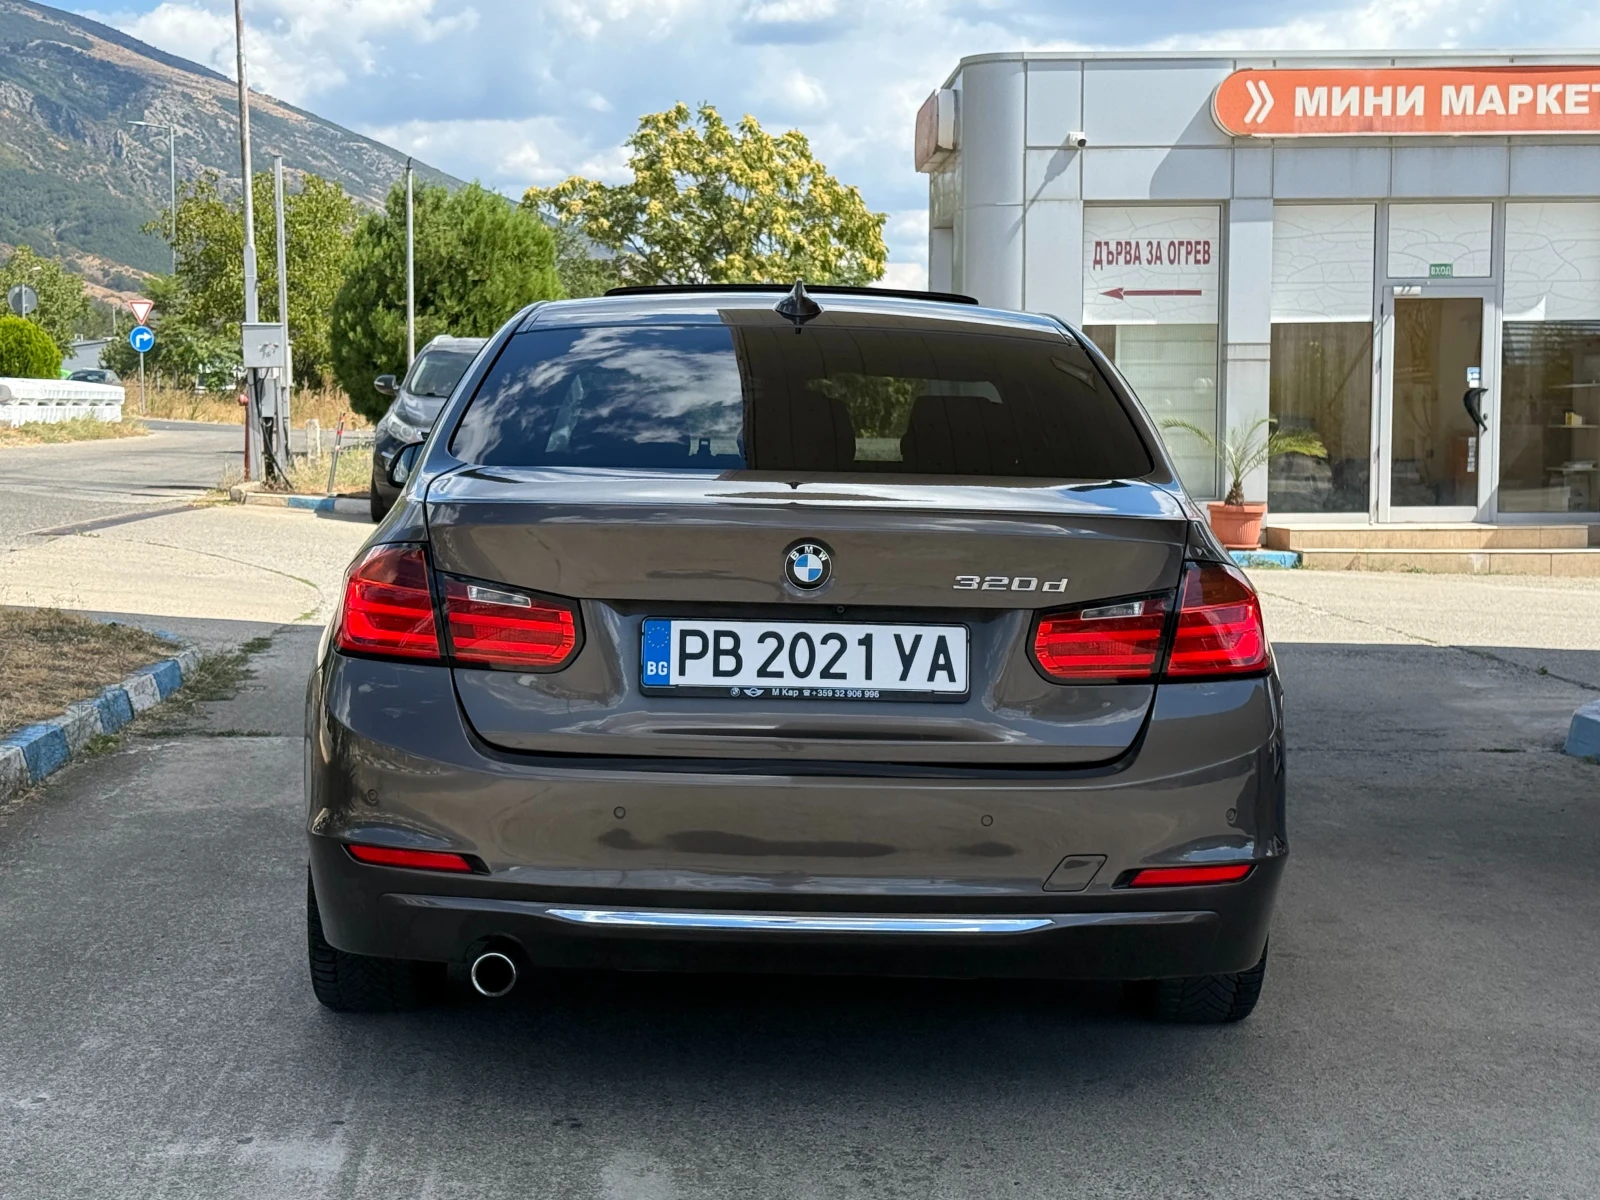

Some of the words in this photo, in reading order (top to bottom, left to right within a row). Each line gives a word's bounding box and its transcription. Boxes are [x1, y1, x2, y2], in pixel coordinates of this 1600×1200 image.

[1294, 85, 1425, 117] МИНИ
[1093, 241, 1142, 271] ДЪРВА
[1146, 240, 1163, 266] ЗА
[1167, 240, 1211, 266] ОГРЕВ
[790, 545, 828, 562] BMW
[952, 575, 1069, 593] 320d
[678, 629, 743, 678] PB
[756, 631, 873, 680] 2021
[646, 661, 668, 676] BG
[834, 689, 845, 698] 32
